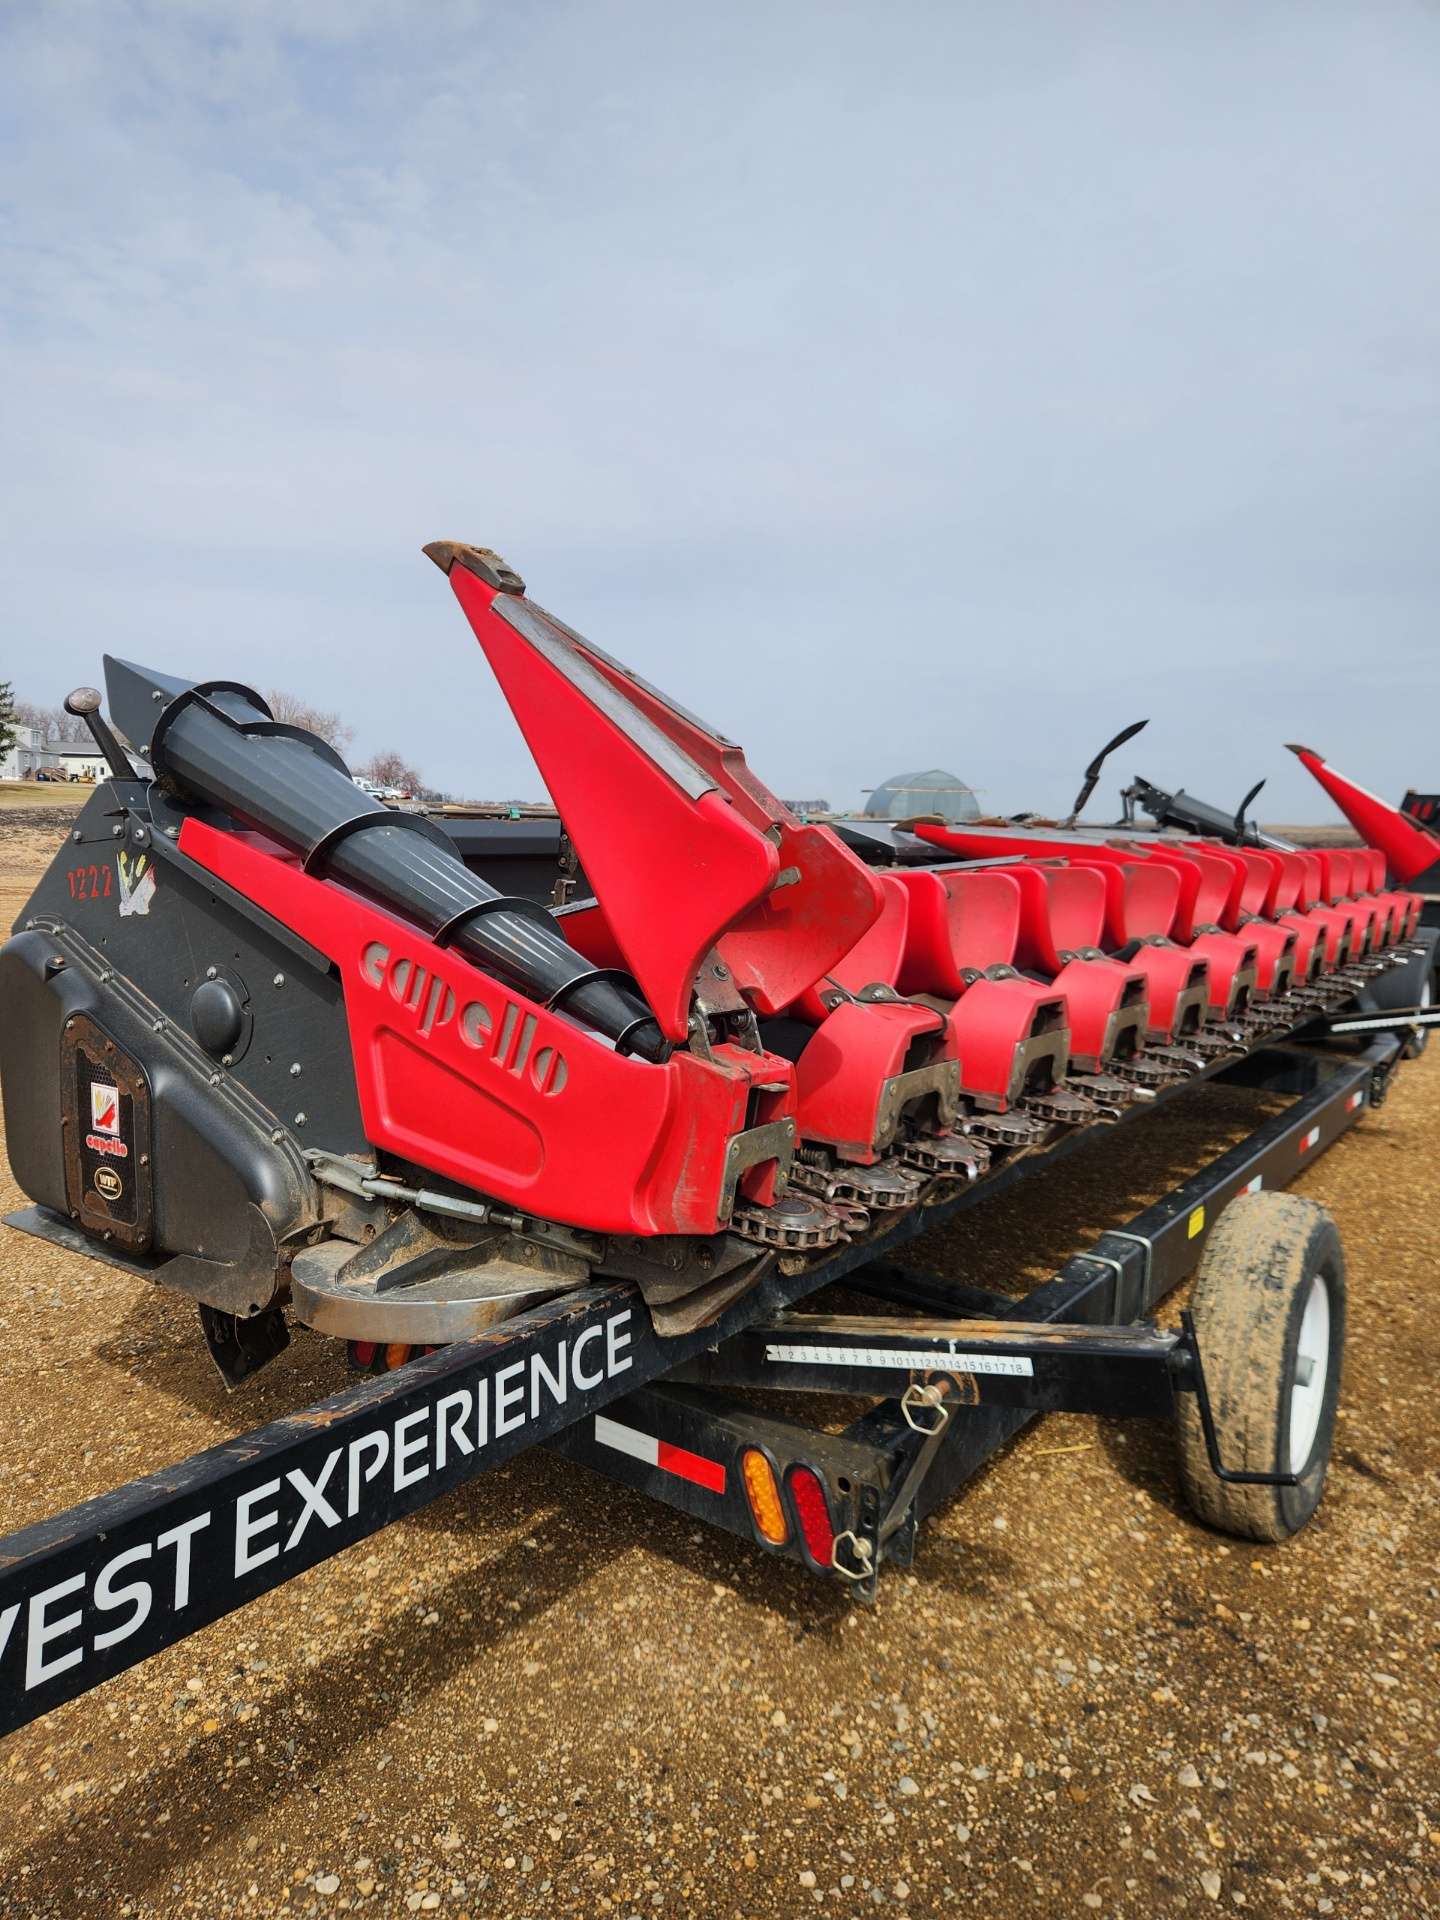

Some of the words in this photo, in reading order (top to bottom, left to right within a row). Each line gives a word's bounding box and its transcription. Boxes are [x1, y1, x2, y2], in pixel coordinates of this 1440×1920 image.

[359, 941, 569, 1097] capello
[86, 1135, 128, 1157] capello
[866, 1355, 872, 1364] 8
[880, 1356, 886, 1365] 9
[892, 1357, 903, 1366] 10
[905, 1358, 917, 1367] 11
[920, 1359, 931, 1368] 12
[935, 1360, 946, 1368] 13
[949, 1360, 961, 1369] 14
[964, 1361, 976, 1370] 15
[979, 1362, 992, 1371] 16
[995, 1363, 1006, 1372] 17
[1010, 1364, 1023, 1373] 18
[234, 1309, 632, 1579] EXPERIENCE
